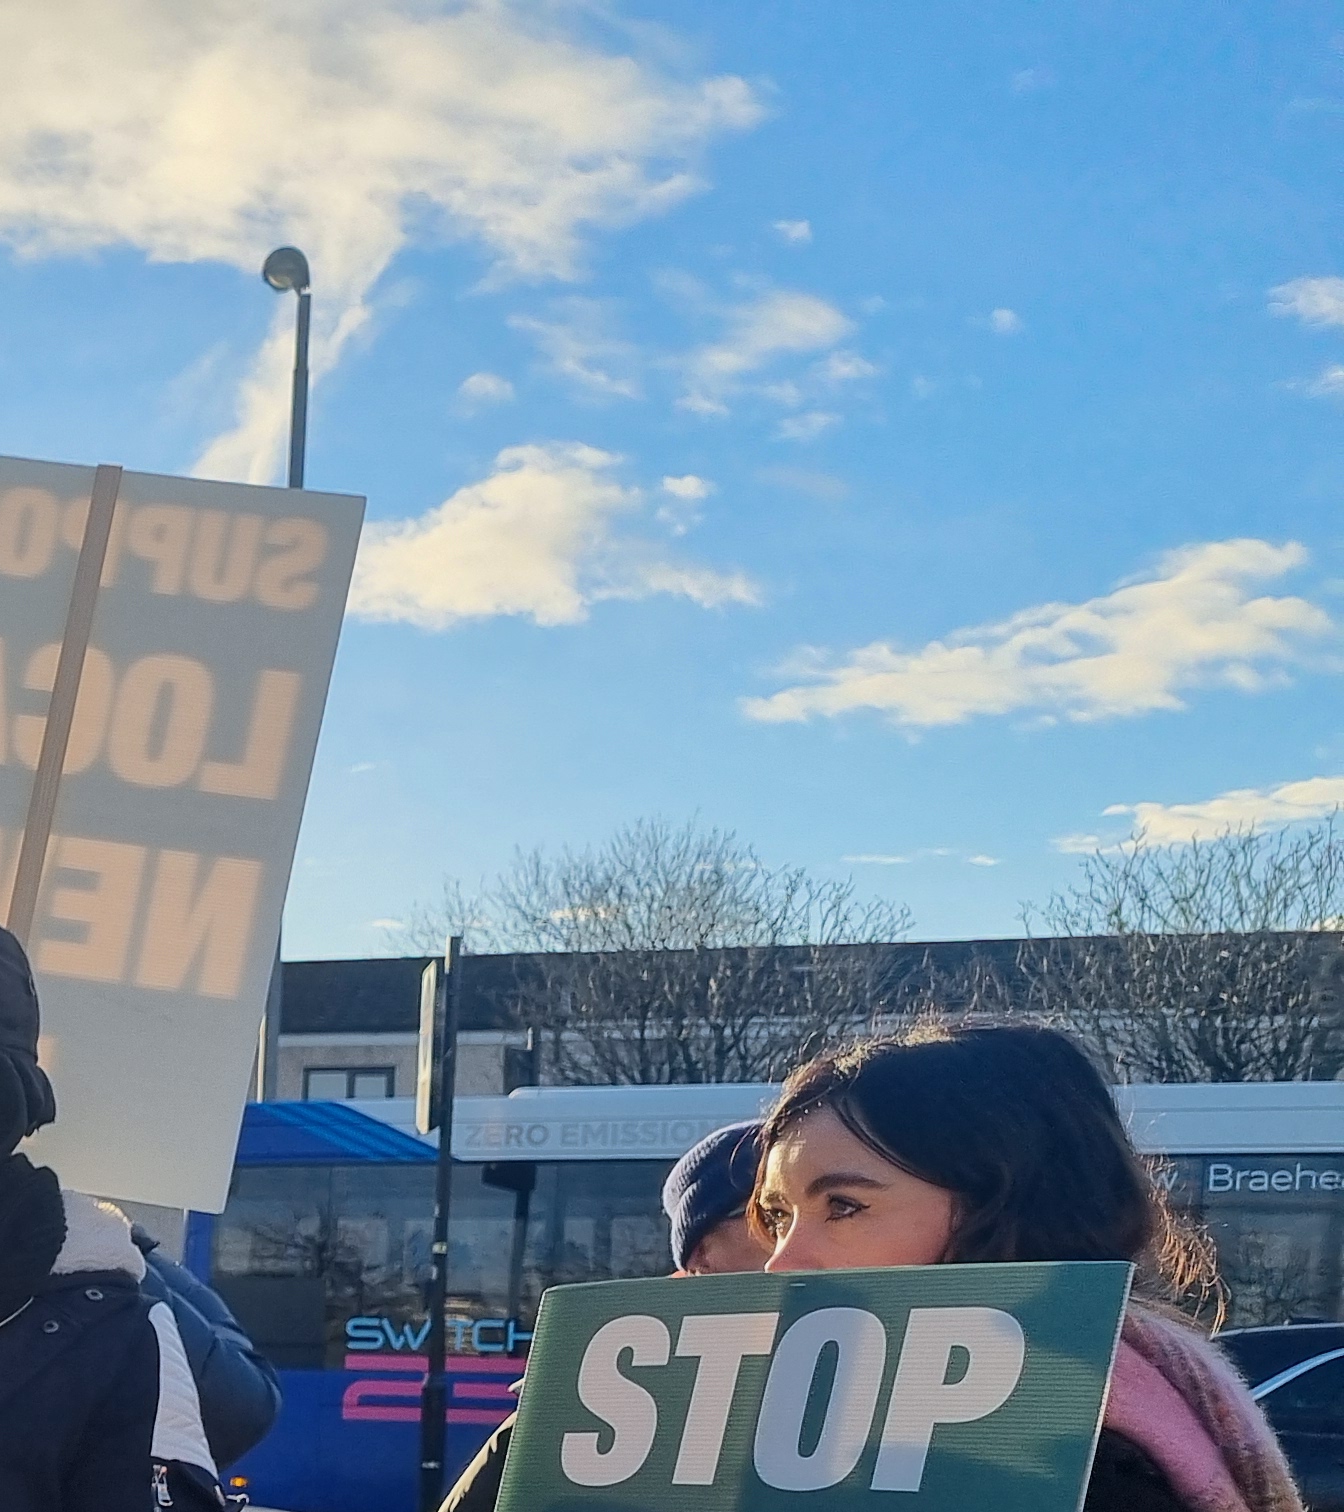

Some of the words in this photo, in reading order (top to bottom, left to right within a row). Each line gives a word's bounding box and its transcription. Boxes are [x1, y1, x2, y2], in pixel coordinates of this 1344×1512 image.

[464, 1122, 550, 1147] ZERO
[1209, 1163, 1344, 1192] Braehe
[345, 1315, 532, 1353] SWTCH
[560, 1306, 1025, 1492] STOP
